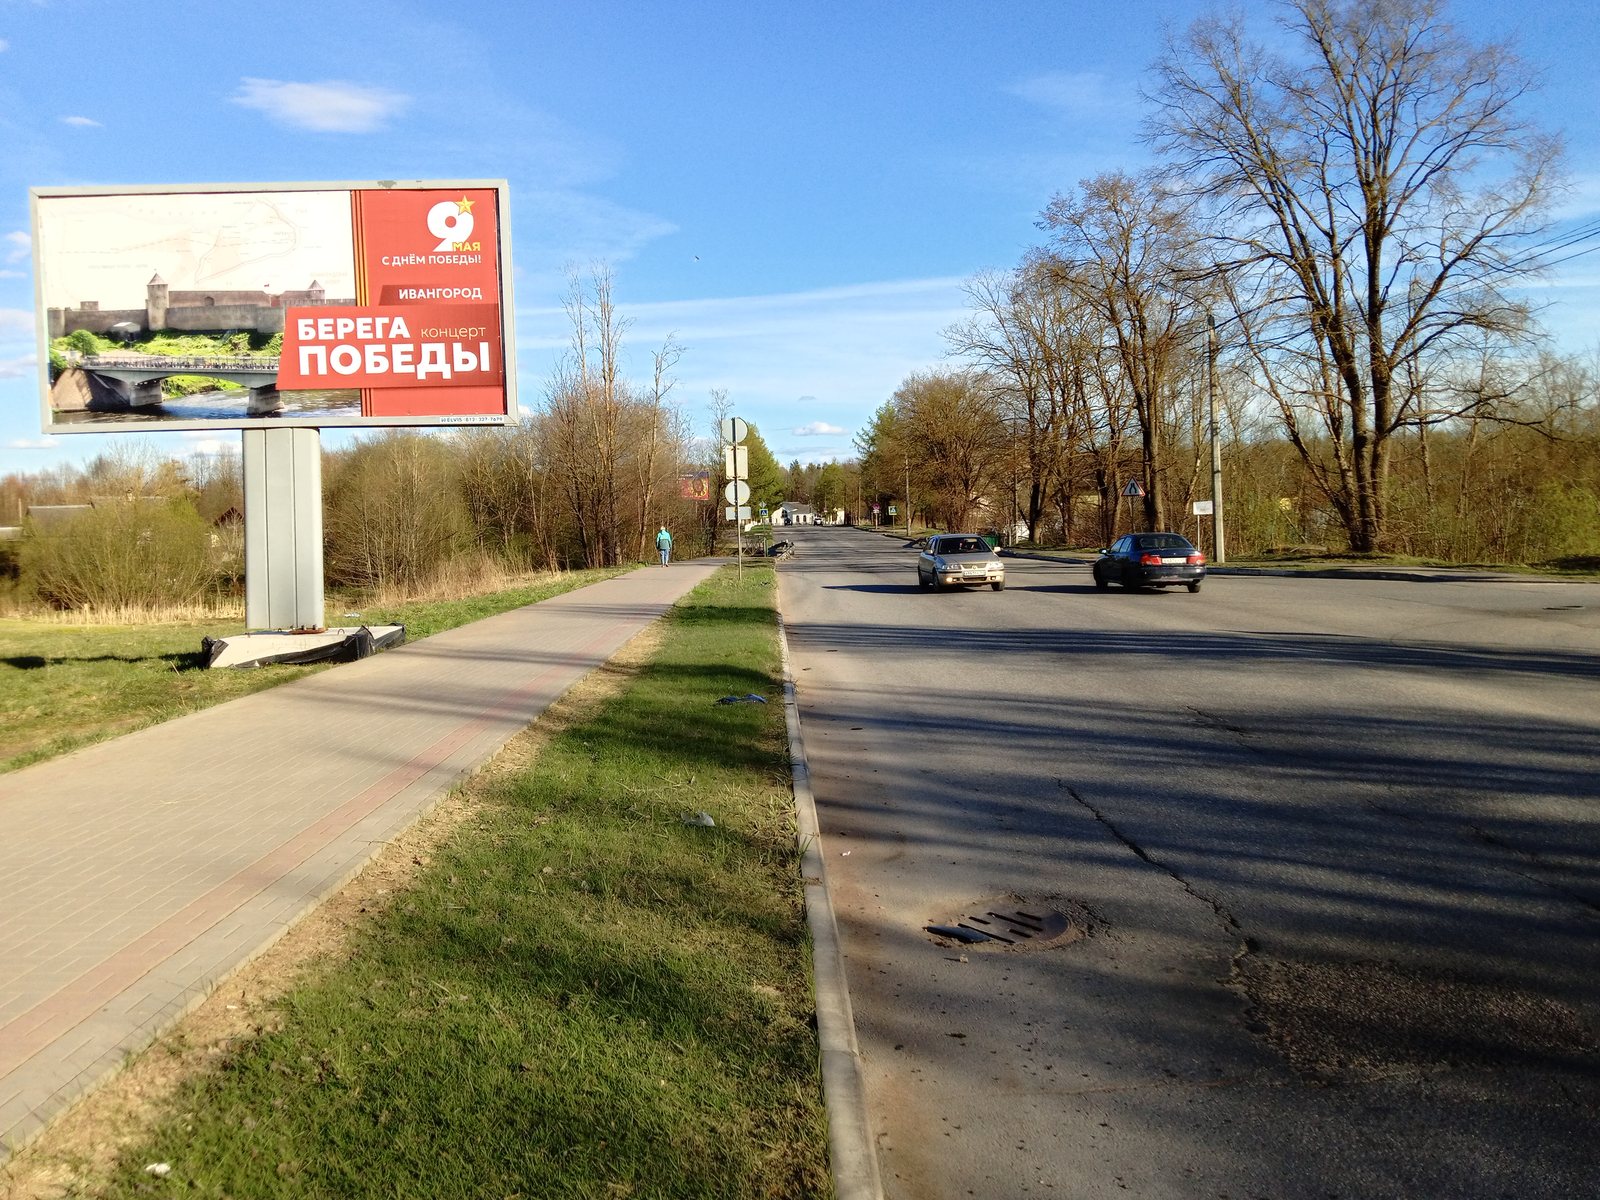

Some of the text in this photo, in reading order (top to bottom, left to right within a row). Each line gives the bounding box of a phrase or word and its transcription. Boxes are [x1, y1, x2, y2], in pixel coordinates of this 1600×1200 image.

[426, 201, 481, 253] 9 МАЯ
[382, 253, 482, 267] С ДНЁМ ПОБЕДЫ!
[399, 288, 482, 300] ИВАНГОРОД
[297, 317, 486, 343] БЕРЕГА концерт
[298, 341, 491, 380] ПОБЕДЫ
